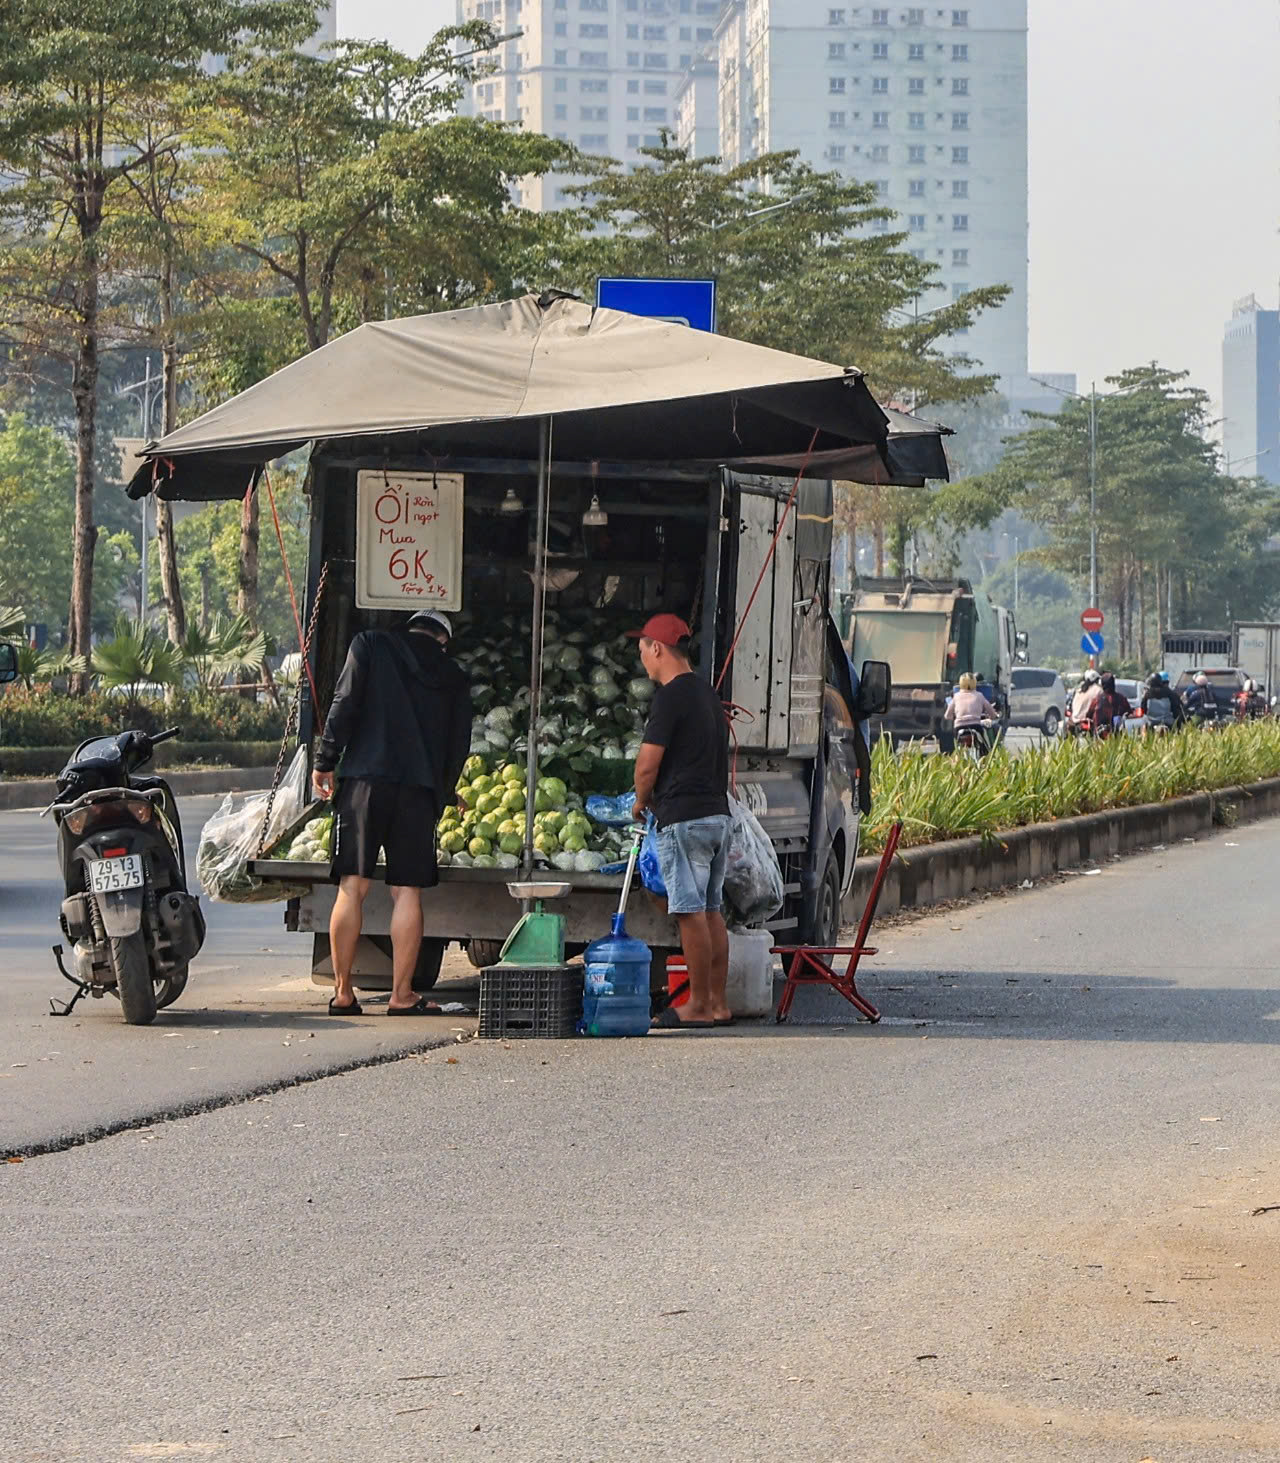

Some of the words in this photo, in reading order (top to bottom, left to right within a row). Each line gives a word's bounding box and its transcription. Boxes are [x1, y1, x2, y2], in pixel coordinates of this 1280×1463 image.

[375, 484, 409, 524] Ổi
[379, 528, 416, 544] Mua
[98, 857, 134, 876] 29-Y3
[95, 870, 140, 891] 575.75
